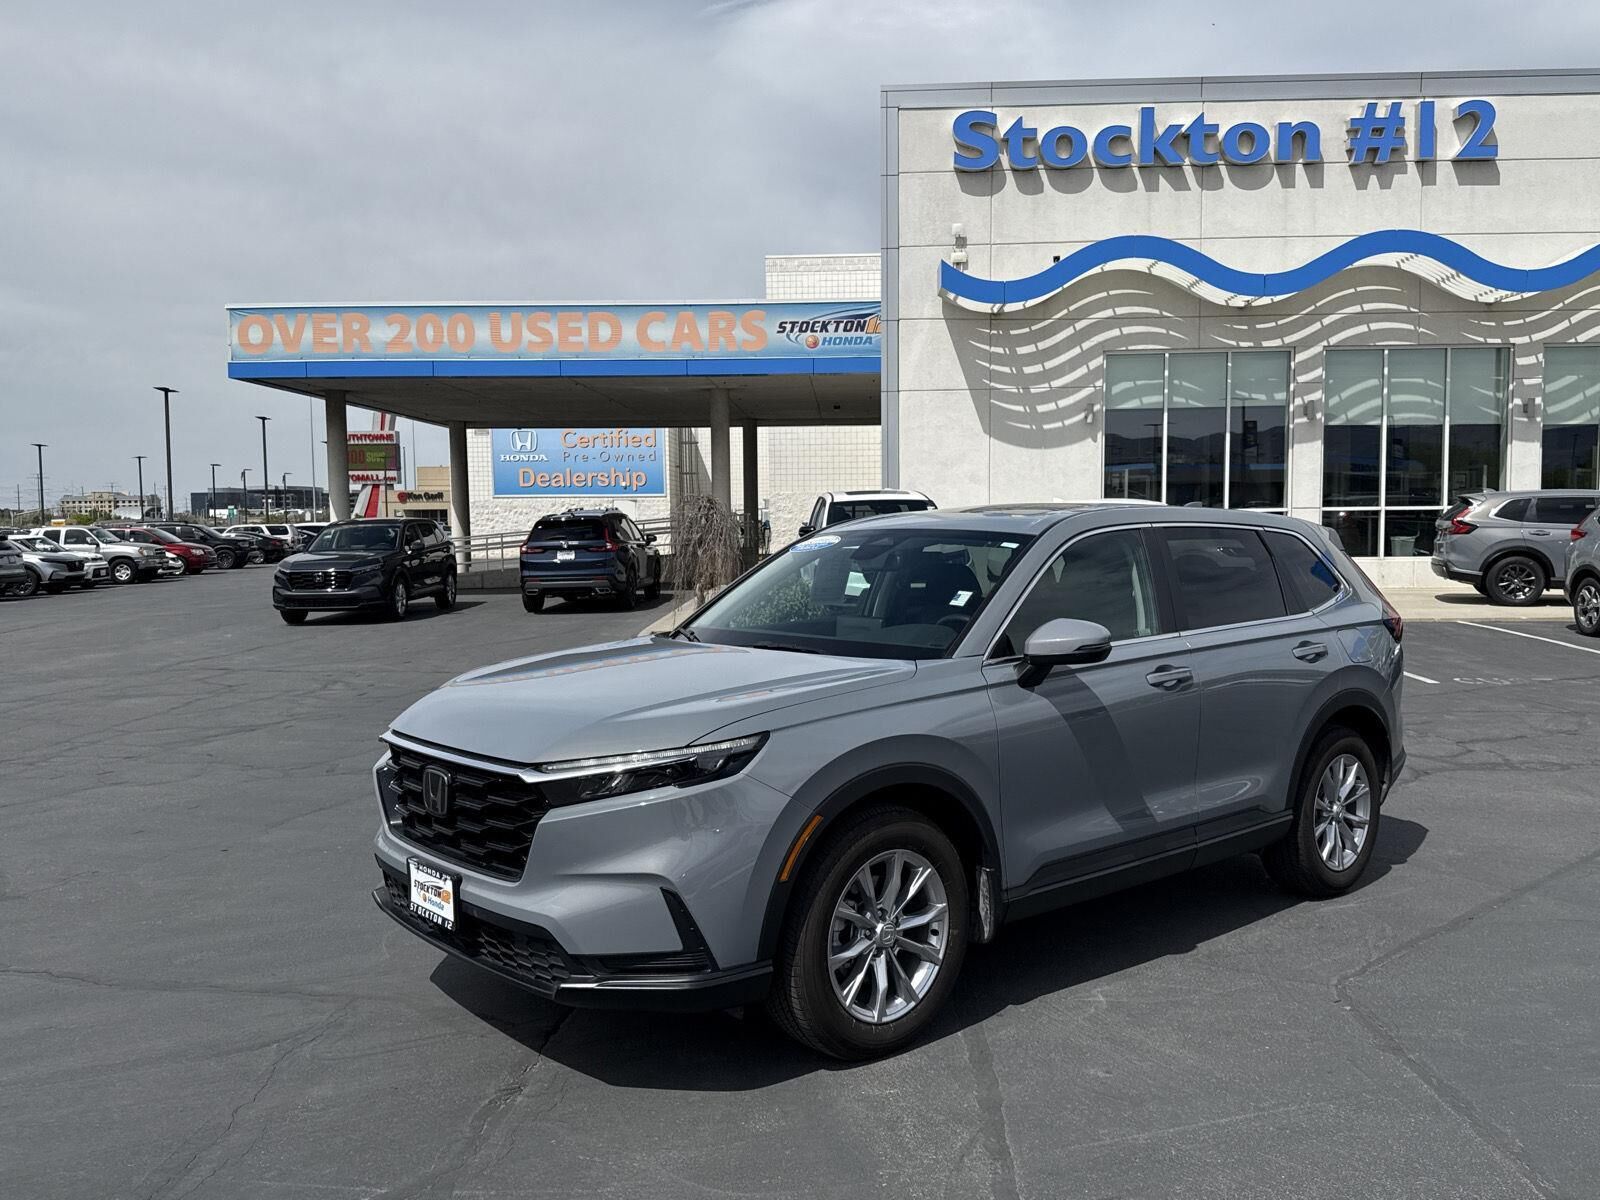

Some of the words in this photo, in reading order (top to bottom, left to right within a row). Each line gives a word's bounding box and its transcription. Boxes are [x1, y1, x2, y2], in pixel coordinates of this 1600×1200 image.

[953, 107, 1321, 171] Stockton
[1350, 99, 1499, 164] #12
[237, 312, 372, 354] OVER
[386, 313, 475, 353] 200
[489, 312, 623, 353] USED
[635, 310, 768, 352] CARS
[777, 320, 867, 334] STOCKTON
[821, 336, 872, 346] HONDA
[560, 428, 657, 448] Certified
[500, 454, 549, 462] HONDA
[563, 451, 657, 462] Pre-Owned
[518, 467, 648, 491] Dealership
[414, 879, 442, 898] STOCKTON
[427, 896, 445, 911] Honda
[410, 902, 443, 925] STOCKTON
[444, 919, 453, 930] 12
